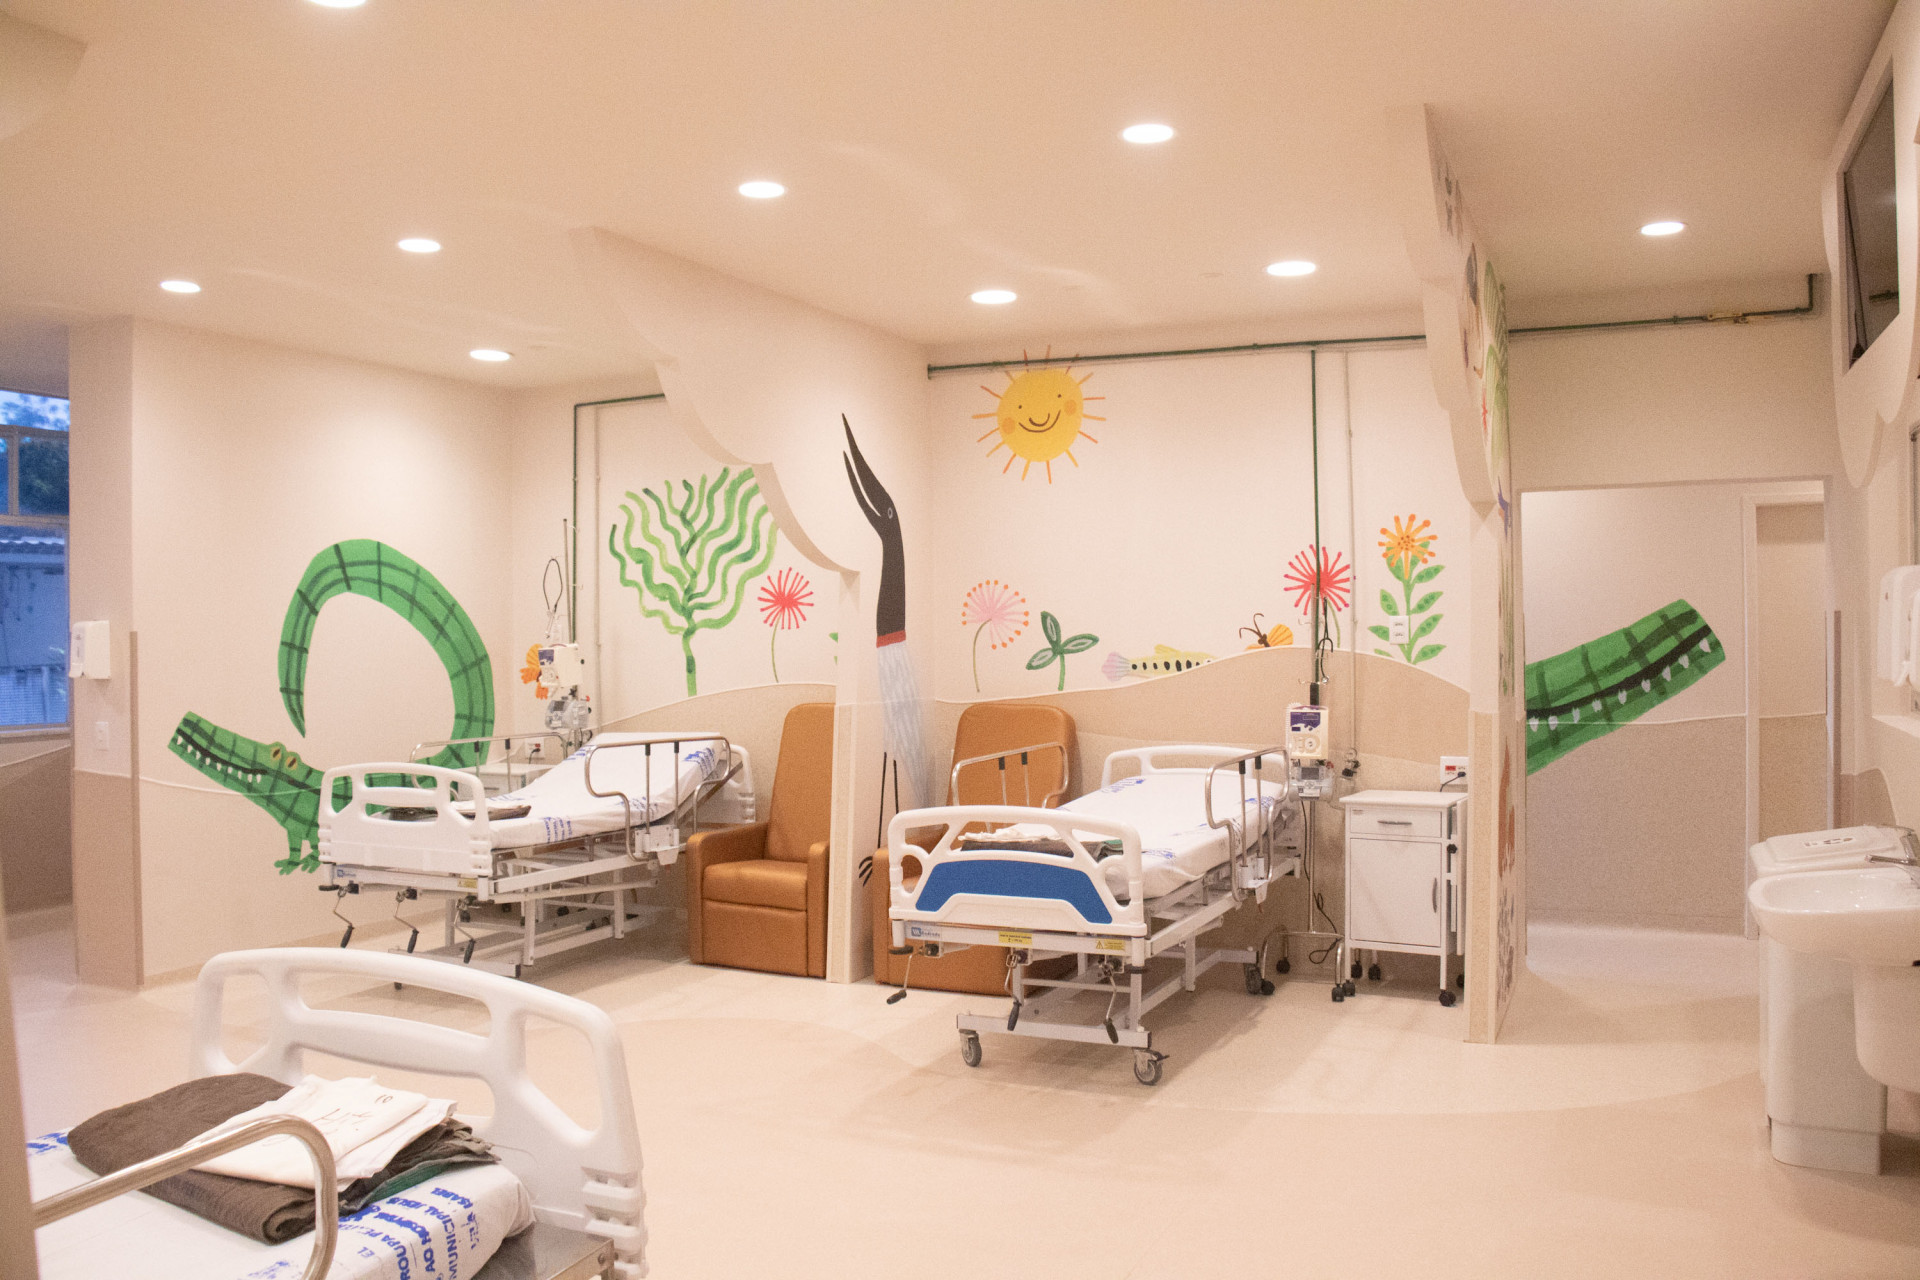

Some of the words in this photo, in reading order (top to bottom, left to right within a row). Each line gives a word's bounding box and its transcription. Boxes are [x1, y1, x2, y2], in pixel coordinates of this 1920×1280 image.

[381, 1234, 411, 1280] ROUPA
[423, 1248, 436, 1272] AO
[425, 1206, 458, 1280] MUNICIPAL
